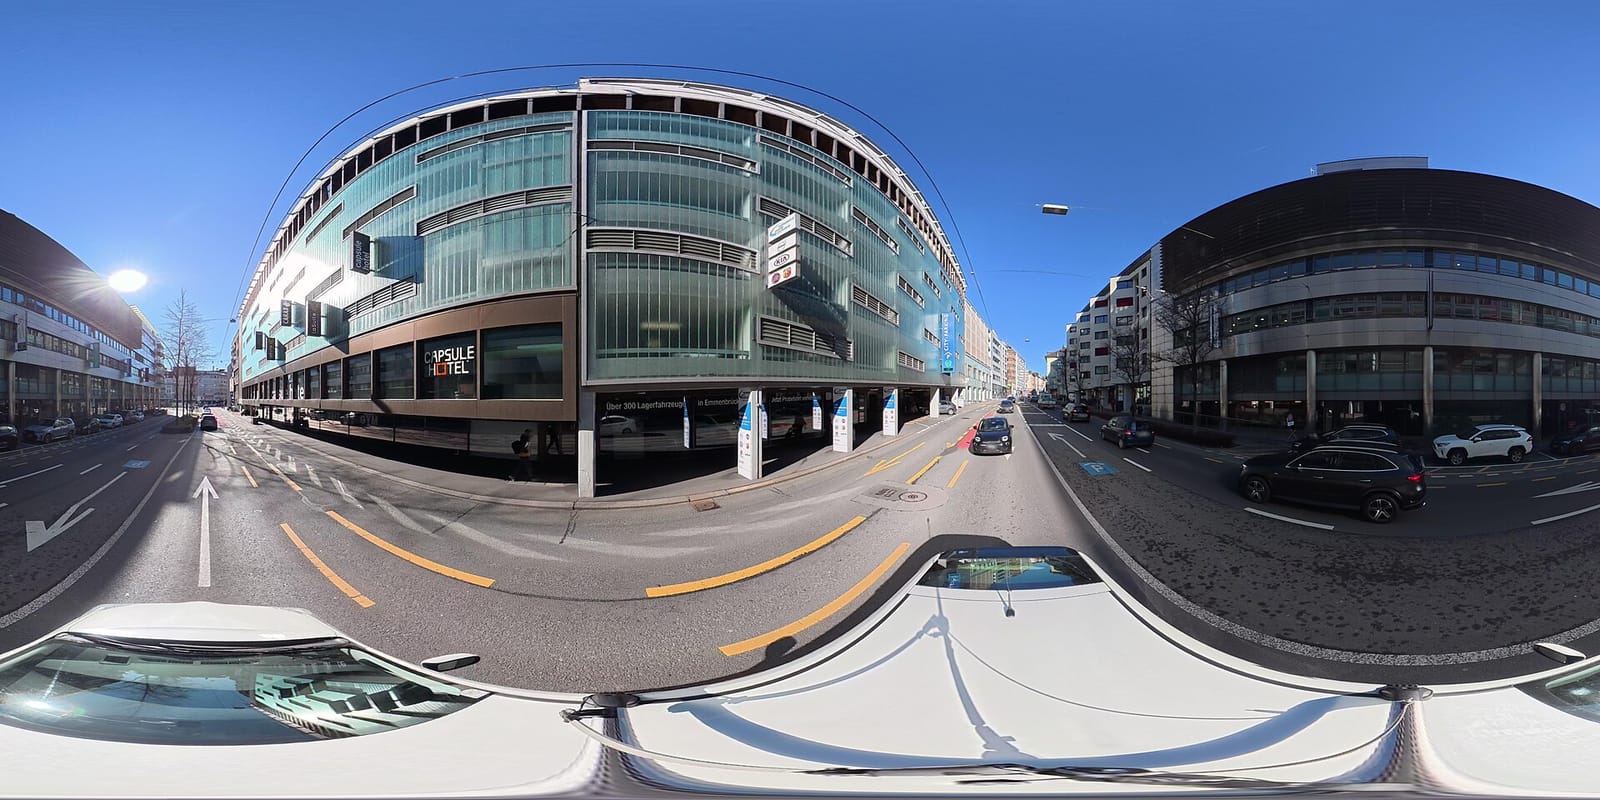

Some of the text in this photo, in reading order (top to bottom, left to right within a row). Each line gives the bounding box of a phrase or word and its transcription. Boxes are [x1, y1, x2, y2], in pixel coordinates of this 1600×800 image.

[424, 345, 475, 364] CAPSULE
[428, 360, 469, 377] HOTEL
[606, 401, 621, 410] Über
[623, 402, 636, 410] 300
[637, 401, 685, 410] Lagerfahrzeug
